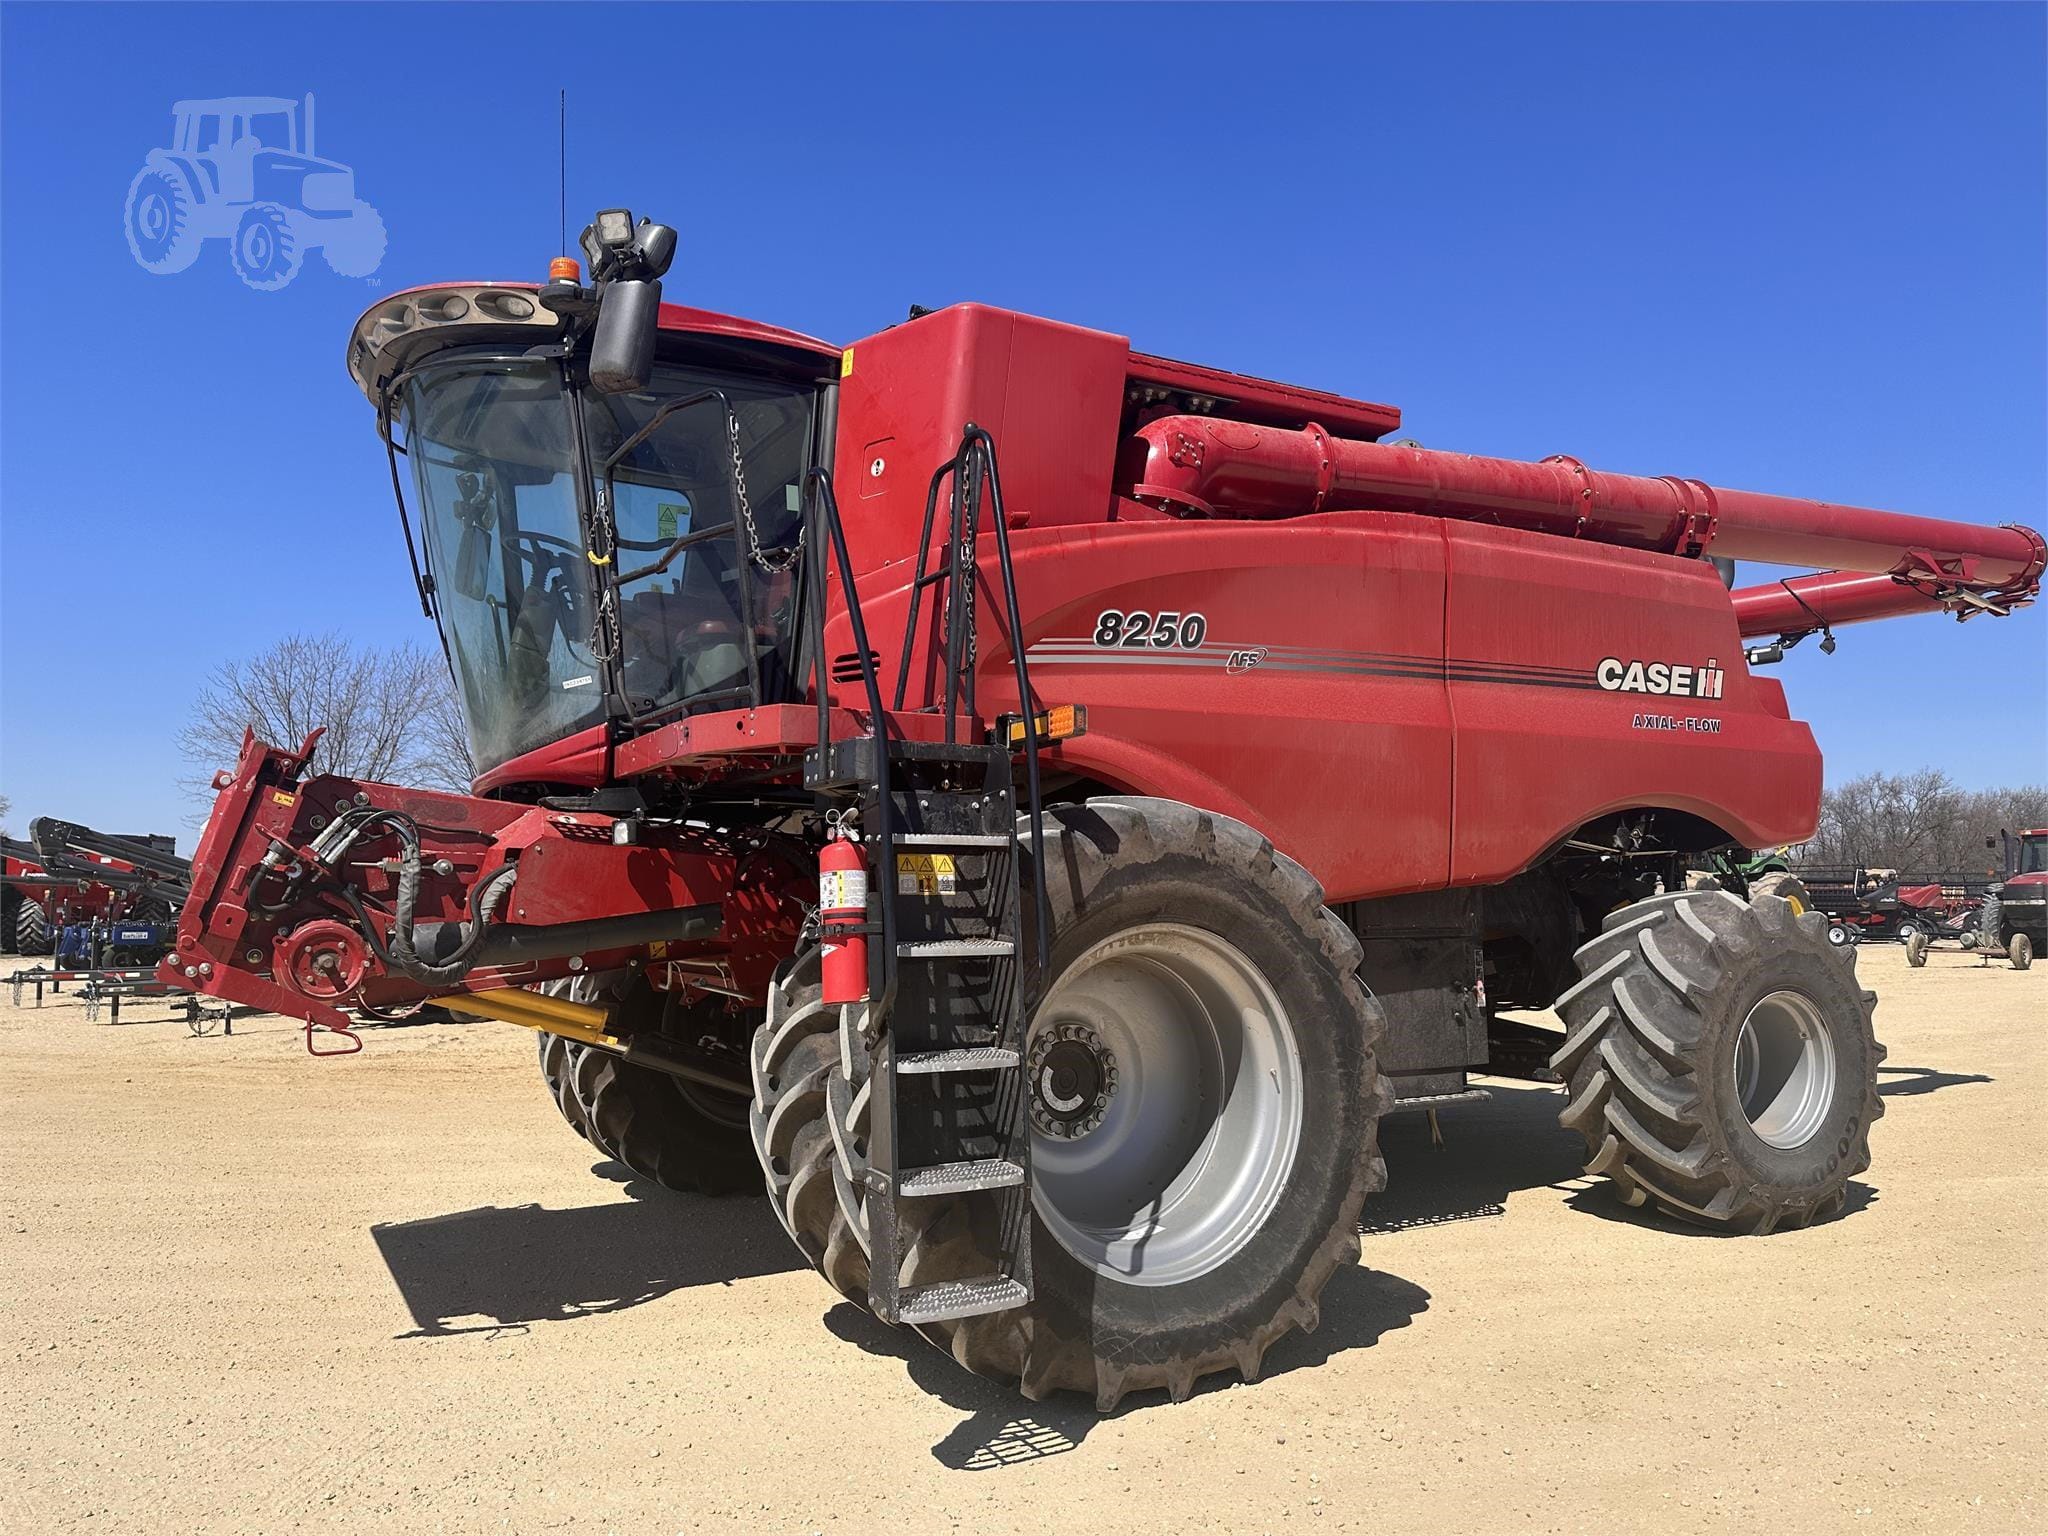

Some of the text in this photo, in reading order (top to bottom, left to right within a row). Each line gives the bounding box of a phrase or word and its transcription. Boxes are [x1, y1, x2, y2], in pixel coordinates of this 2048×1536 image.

[1094, 610, 1206, 649] 8250
[1226, 650, 1260, 668] AFS
[1597, 657, 1692, 696] CASE
[1632, 714, 1721, 733] AXIAL-FLOW
